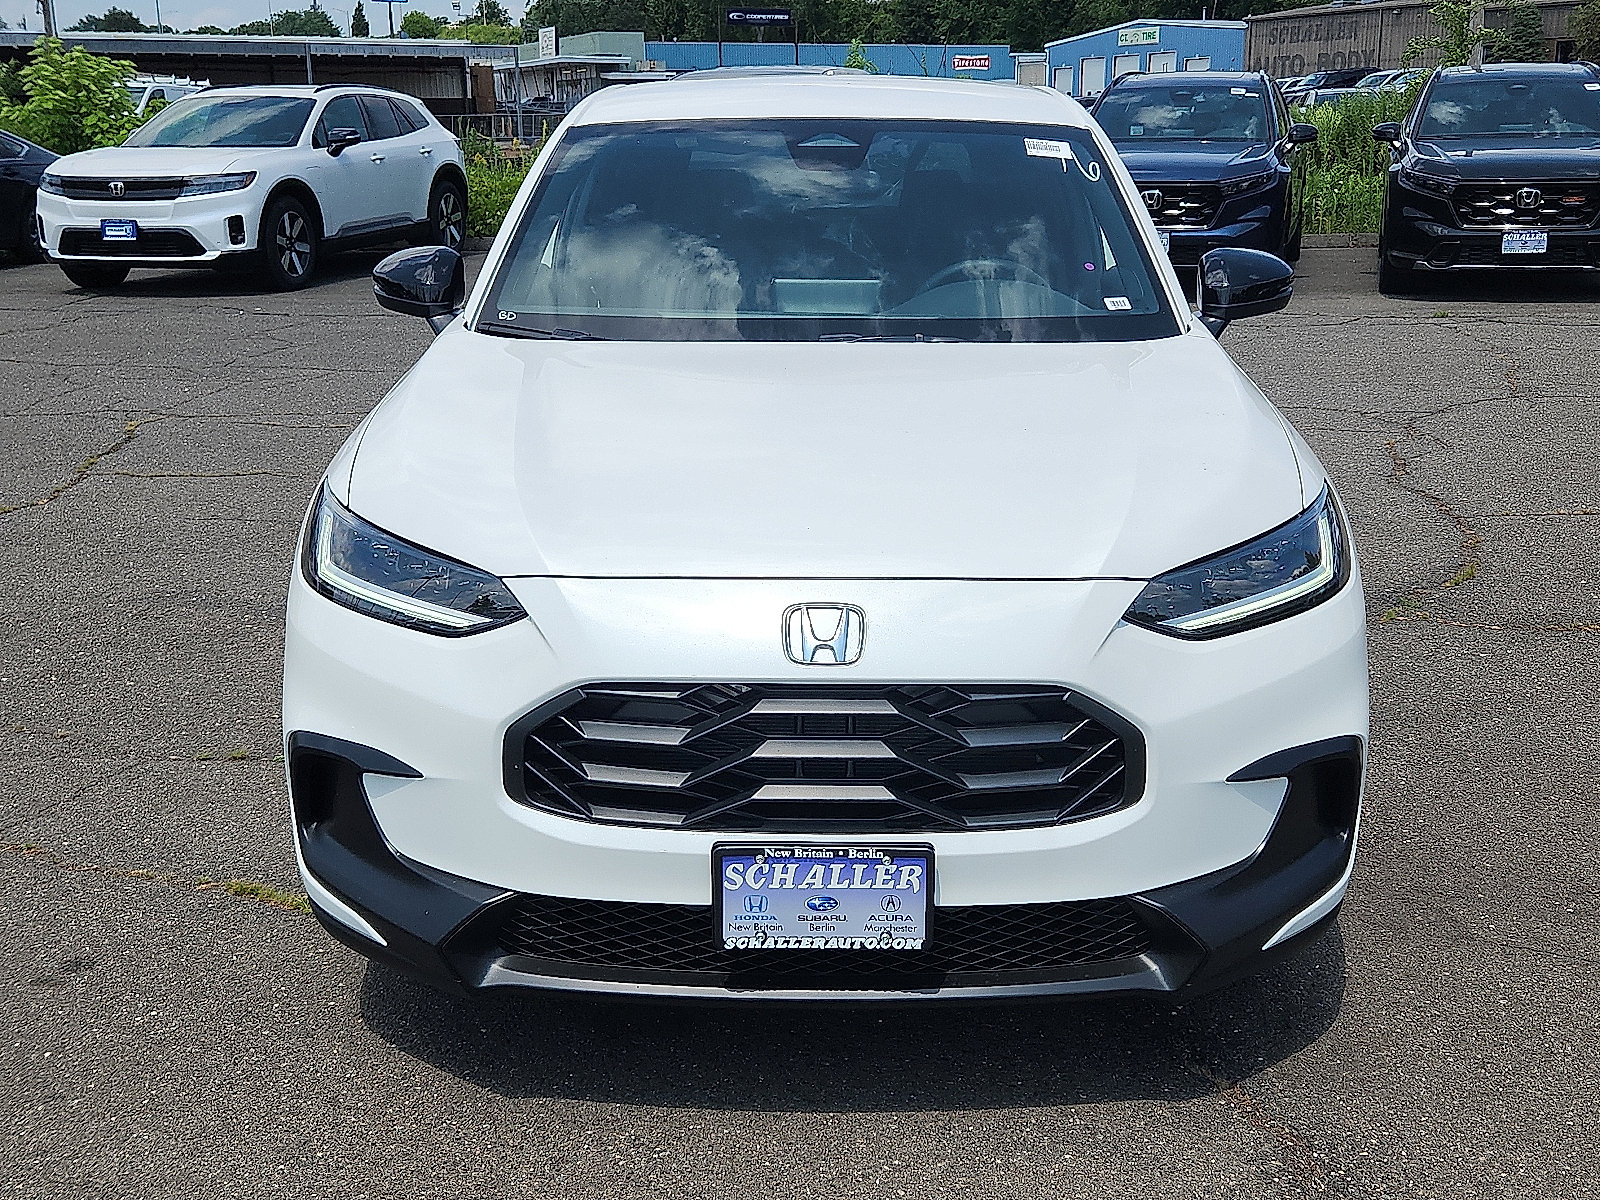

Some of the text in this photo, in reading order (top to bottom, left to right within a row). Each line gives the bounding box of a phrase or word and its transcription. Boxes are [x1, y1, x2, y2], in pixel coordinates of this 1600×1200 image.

[1141, 30, 1157, 41] TIRE
[1253, 48, 1376, 76] AUTO BODY
[1503, 233, 1548, 241] SCHALLER
[764, 848, 884, 859] New Britain Berlin
[724, 863, 923, 894] SCHALLER
[797, 914, 847, 922] SUBARU
[868, 914, 914, 922] ACURA
[728, 922, 783, 932] New Britain
[809, 922, 836, 932] Berlin
[863, 923, 918, 933] Manchester
[724, 935, 924, 950] SCHALLERAUTO.COM
